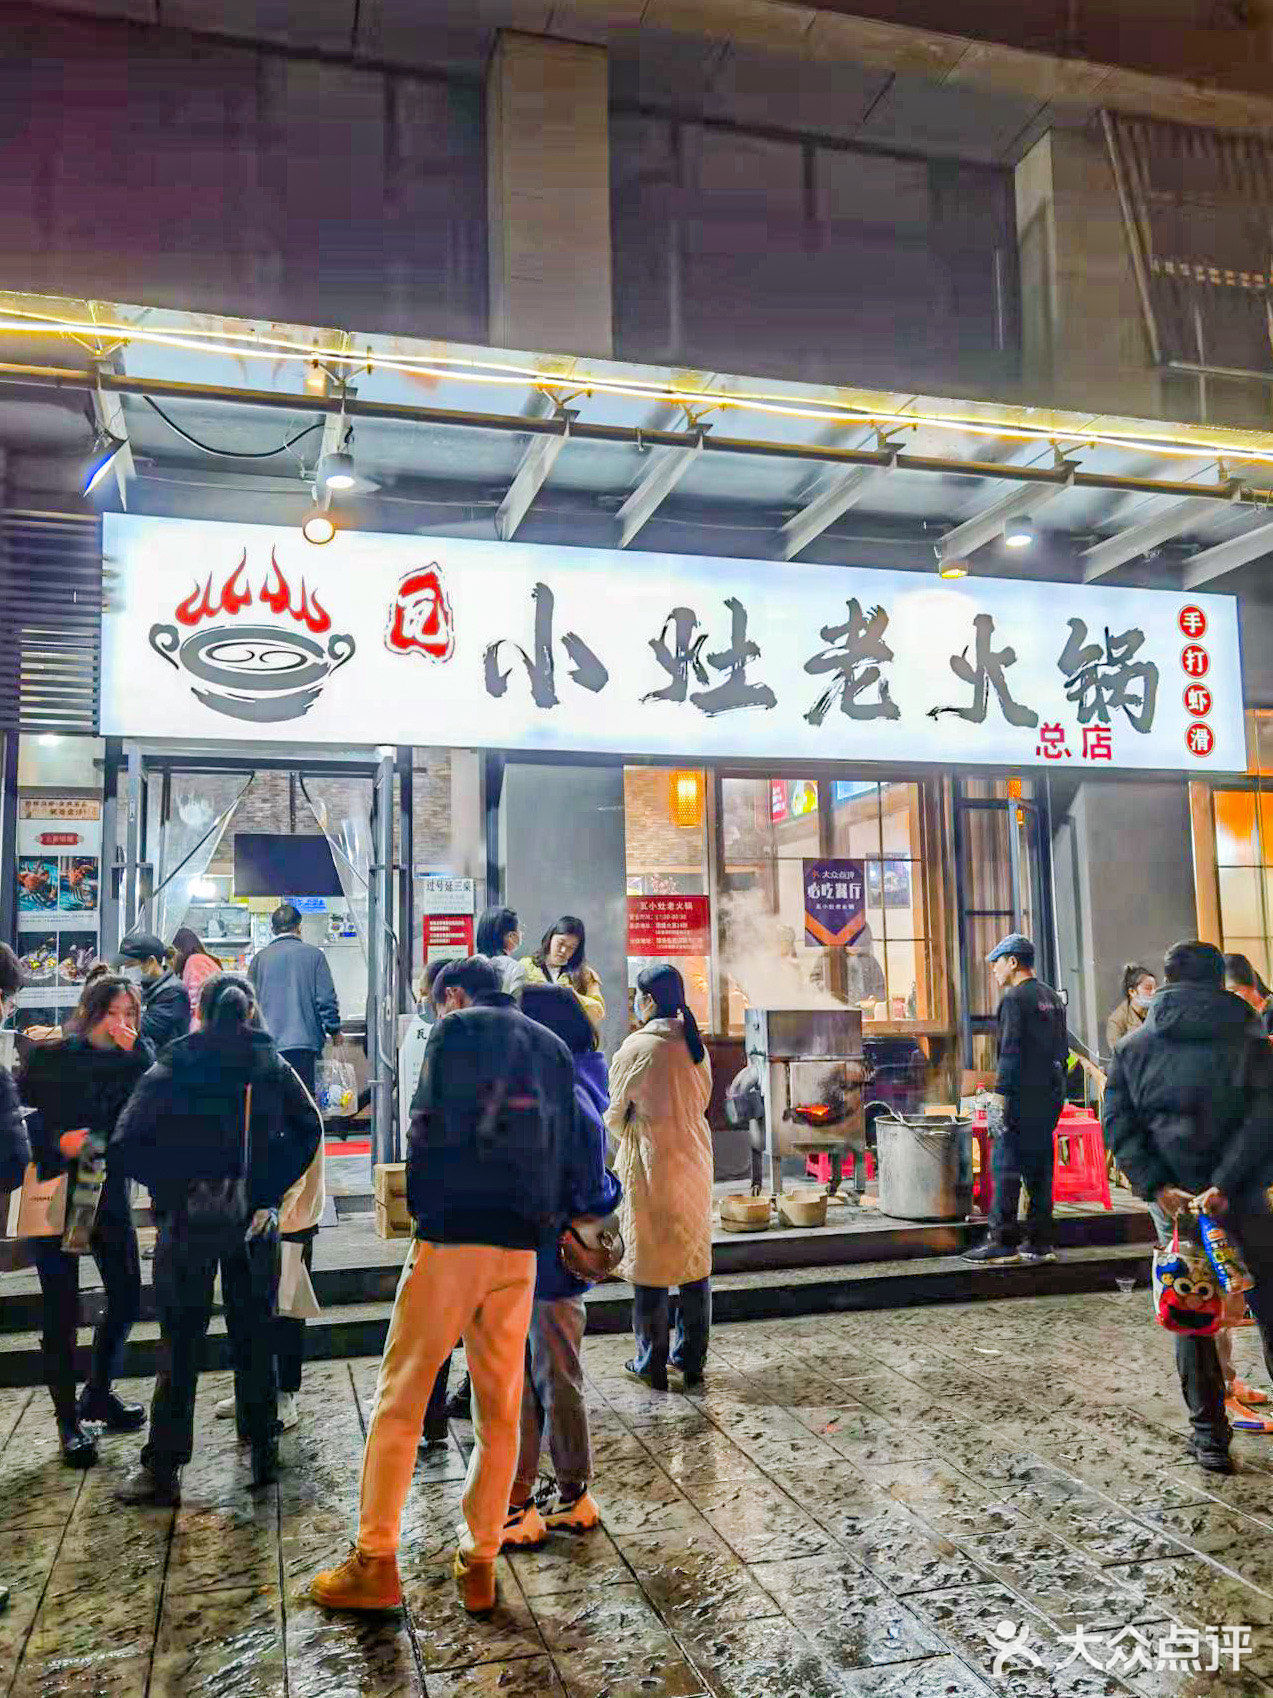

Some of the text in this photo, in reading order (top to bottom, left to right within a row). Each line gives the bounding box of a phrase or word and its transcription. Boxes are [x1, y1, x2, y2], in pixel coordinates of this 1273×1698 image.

[1182, 609, 1212, 754] 手打虾滑
[1036, 723, 1112, 760] 总店
[807, 882, 862, 900] 必吃餐厅
